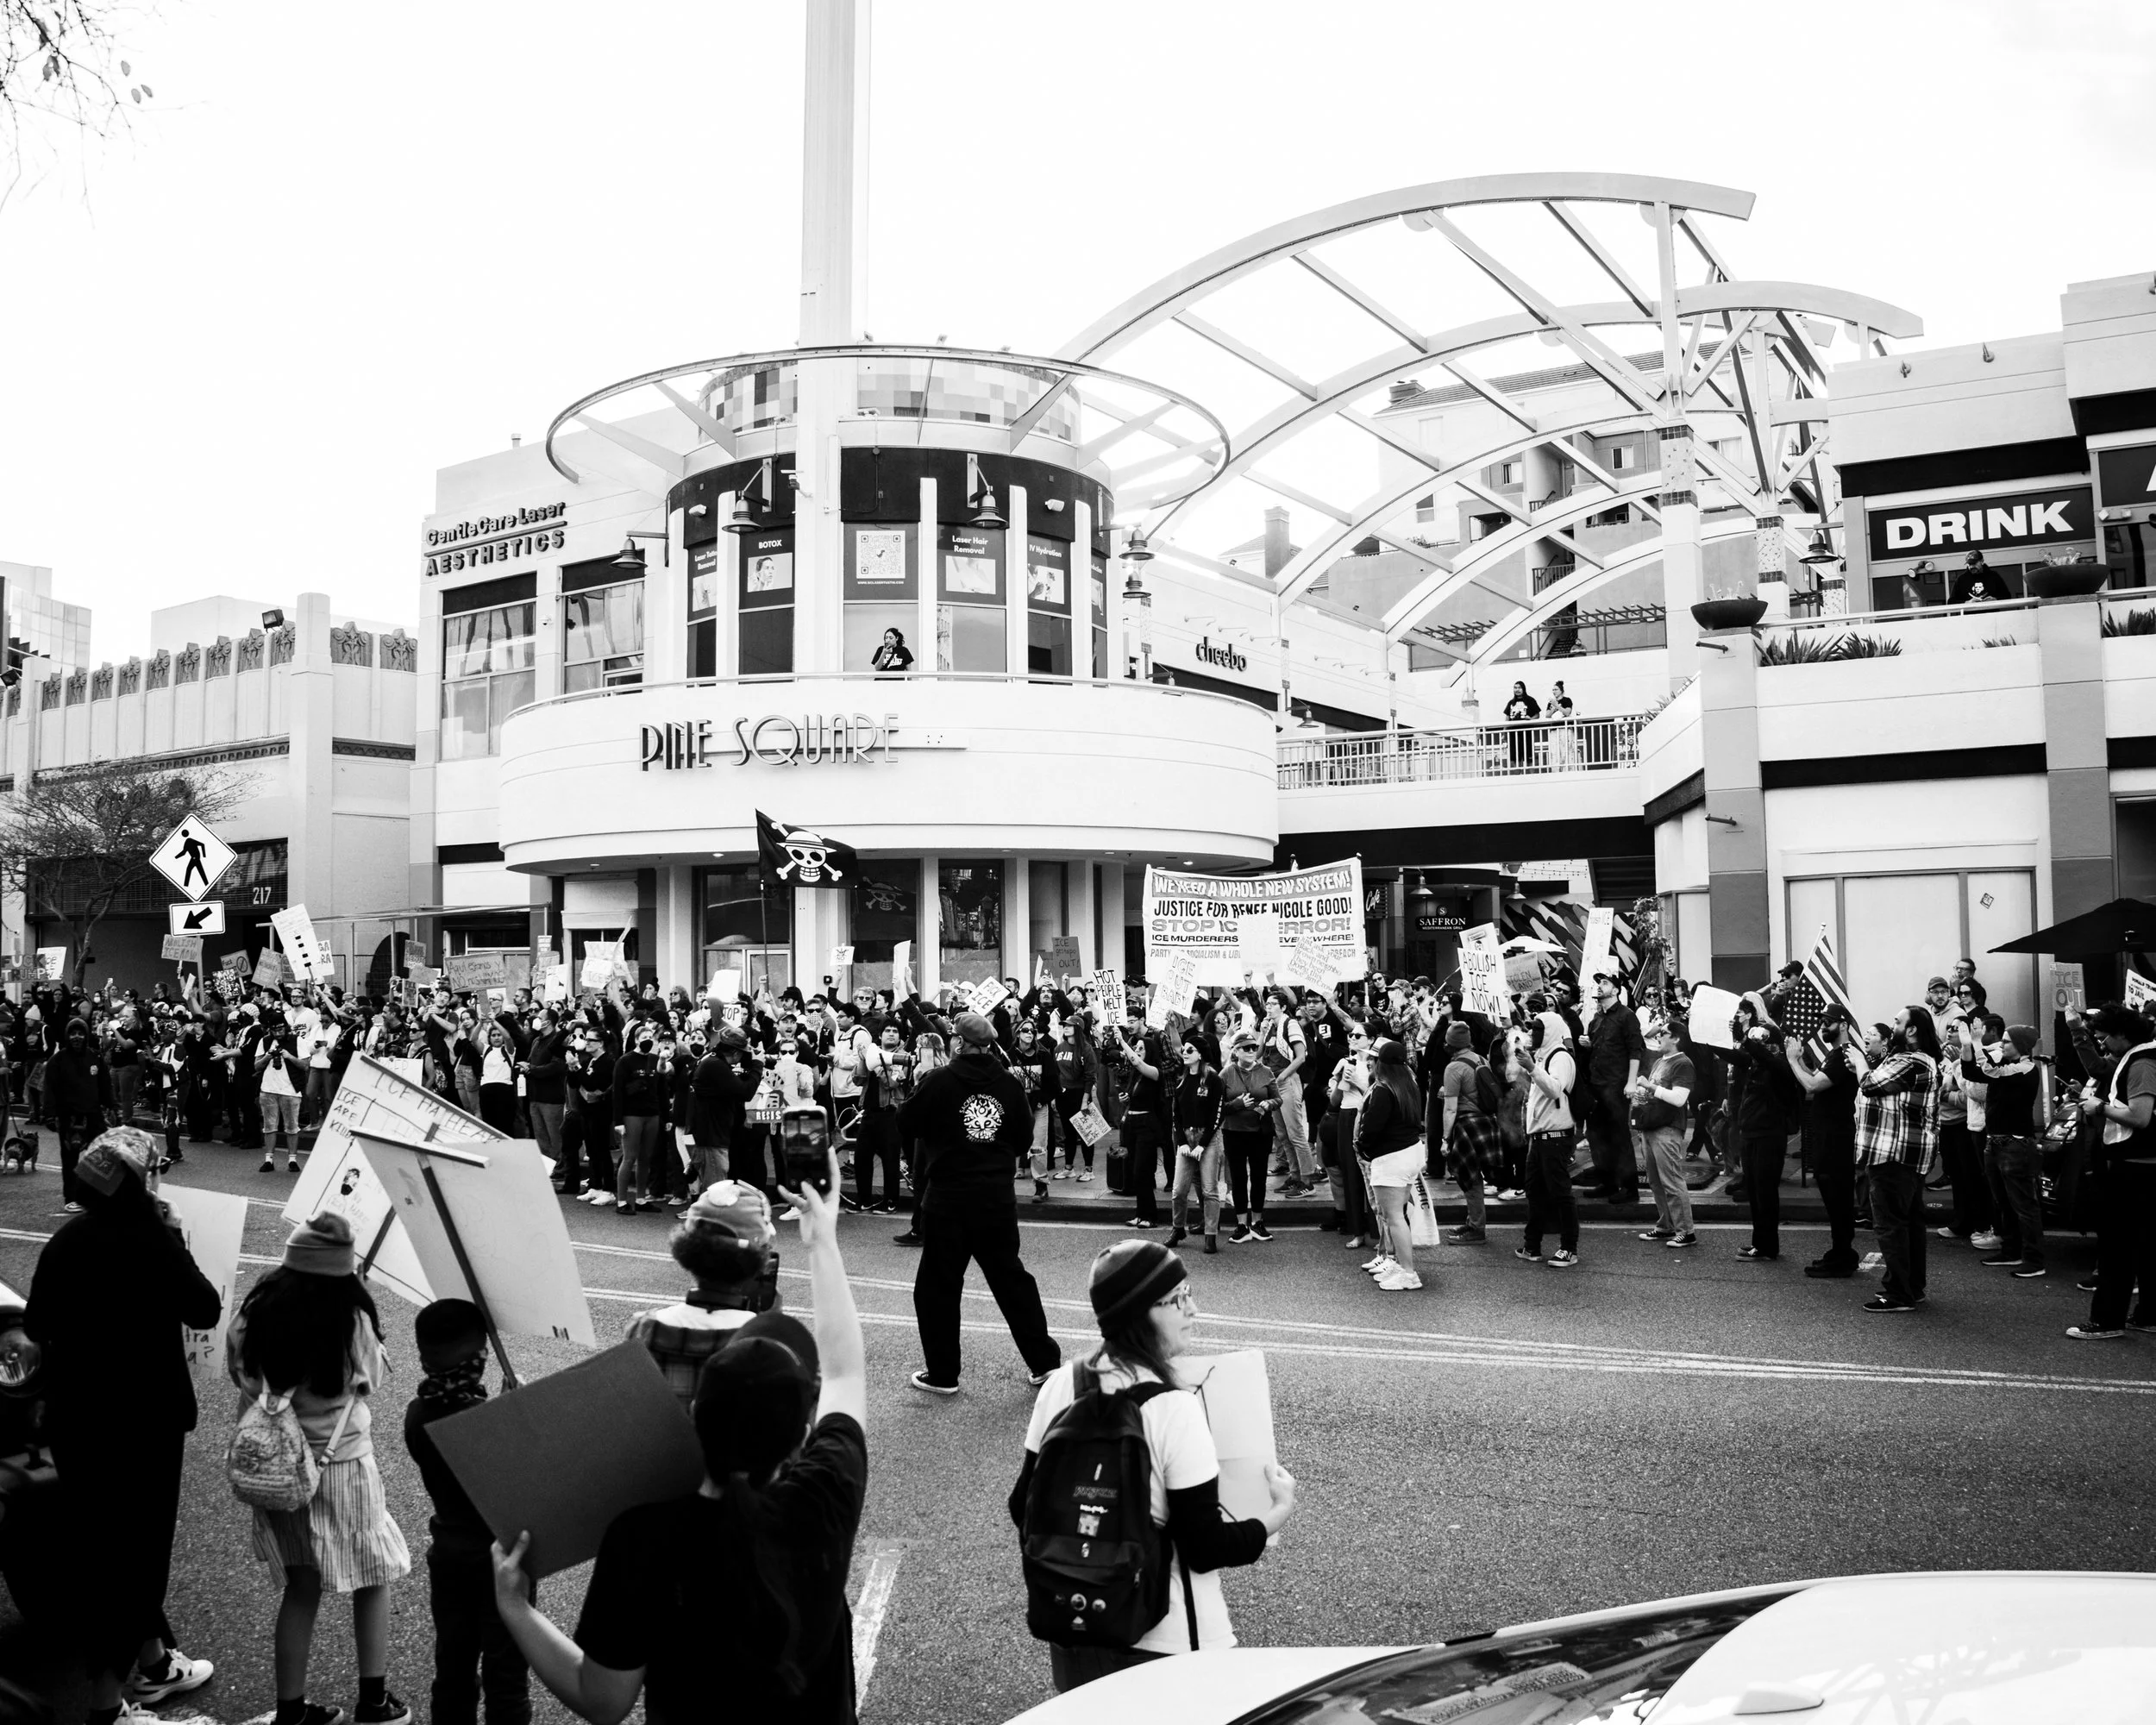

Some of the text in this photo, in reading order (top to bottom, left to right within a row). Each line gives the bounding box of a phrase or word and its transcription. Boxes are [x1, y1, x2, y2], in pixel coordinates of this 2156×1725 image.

[426, 502, 566, 546] GentleCare Laser
[1886, 500, 2073, 549] DRINK
[759, 539, 782, 549] BOTOX
[952, 535, 988, 548] Laser Hair
[954, 545, 985, 555] Removal
[426, 530, 565, 576] AESTHETICS
[1036, 546, 1062, 558] Hydration
[1196, 637, 1247, 672] cheebo
[640, 712, 899, 771] PINE SQUARE
[1156, 870, 1351, 898] WE NEED A WHOLE NEW SYSTEM!
[253, 887, 271, 905] 217
[1155, 900, 1203, 917] JUSTICE
[1206, 901, 1228, 918] FOR
[1272, 900, 1313, 919] NICOLE
[1317, 897, 1351, 916] GOOD!
[1152, 918, 1351, 934] STOP IC ERROR!
[1420, 917, 1466, 925] SAFFRON
[1279, 934, 1354, 943] EVEWHERE!
[1, 954, 46, 968] FUCK
[1059, 959, 1080, 968] OUT!
[1172, 955, 1196, 977] ICE
[1463, 951, 1496, 974] ABOLISH
[2, 969, 46, 982] TRUMP
[1093, 969, 1115, 985] HOT
[1167, 969, 1192, 994] OUT
[1469, 971, 1489, 994] ICE
[2055, 971, 2080, 988] ICE
[1096, 984, 1122, 998] PEOPLE
[1513, 980, 1533, 992] LAND
[972, 992, 993, 1009] ICE
[1104, 997, 1121, 1010] MELT
[1471, 992, 1501, 1016] NOW!
[2056, 988, 2082, 1008] OUT
[724, 1007, 740, 1020] TOP
[1107, 1012, 1120, 1025] ICE
[374, 1071, 411, 1099] ICE
[337, 1087, 360, 1107] ICE
[959, 1095, 975, 1113] SACRED
[334, 1105, 358, 1121] ARE
[756, 1111, 781, 1120] RESIS
